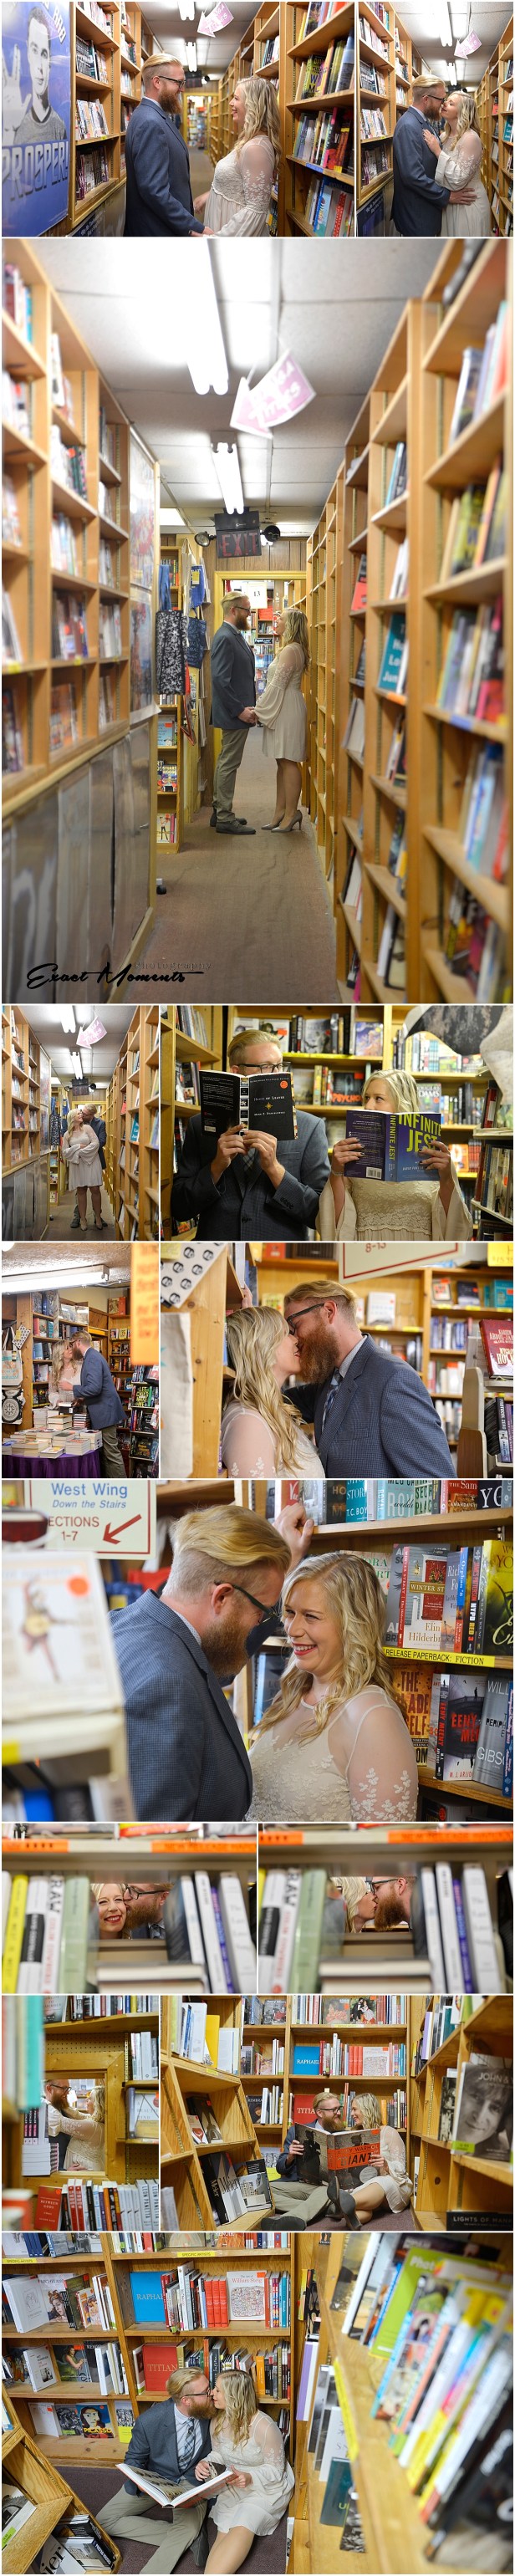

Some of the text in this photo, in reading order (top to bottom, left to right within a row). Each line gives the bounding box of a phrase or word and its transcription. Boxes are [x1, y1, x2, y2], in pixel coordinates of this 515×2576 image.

[2, 141, 69, 201] PROSPER!
[222, 532, 258, 557] EXIT
[398, 1113, 441, 1136] INFINITE
[51, 1482, 128, 1499] West Wing
[460, 1480, 477, 1489] Sam
[52, 1499, 126, 1508] Down the Stairs
[48, 1516, 99, 1528] ECTIONS
[61, 1531, 79, 1541] 1-7
[410, 1584, 436, 1592] WINTER
[471, 1576, 479, 1601] PATTERSON
[425, 1622, 441, 1632] Elin
[385, 1649, 485, 1665] RELEASE PAPERBACK: FICTION
[401, 1671, 419, 1692] THE
[402, 1693, 429, 1715] LADE
[437, 1702, 447, 1746] EENY MEENY
[451, 1713, 477, 1728] EENY
[48, 1878, 64, 1914] RAW
[286, 1873, 300, 1907] RAW
[478, 2072, 510, 2084] JOHN &
[211, 2179, 220, 2197] Meier
[219, 2175, 239, 2195] Meier
[146, 2364, 179, 2372] TITIAN
[41, 2546, 66, 2573] ier
